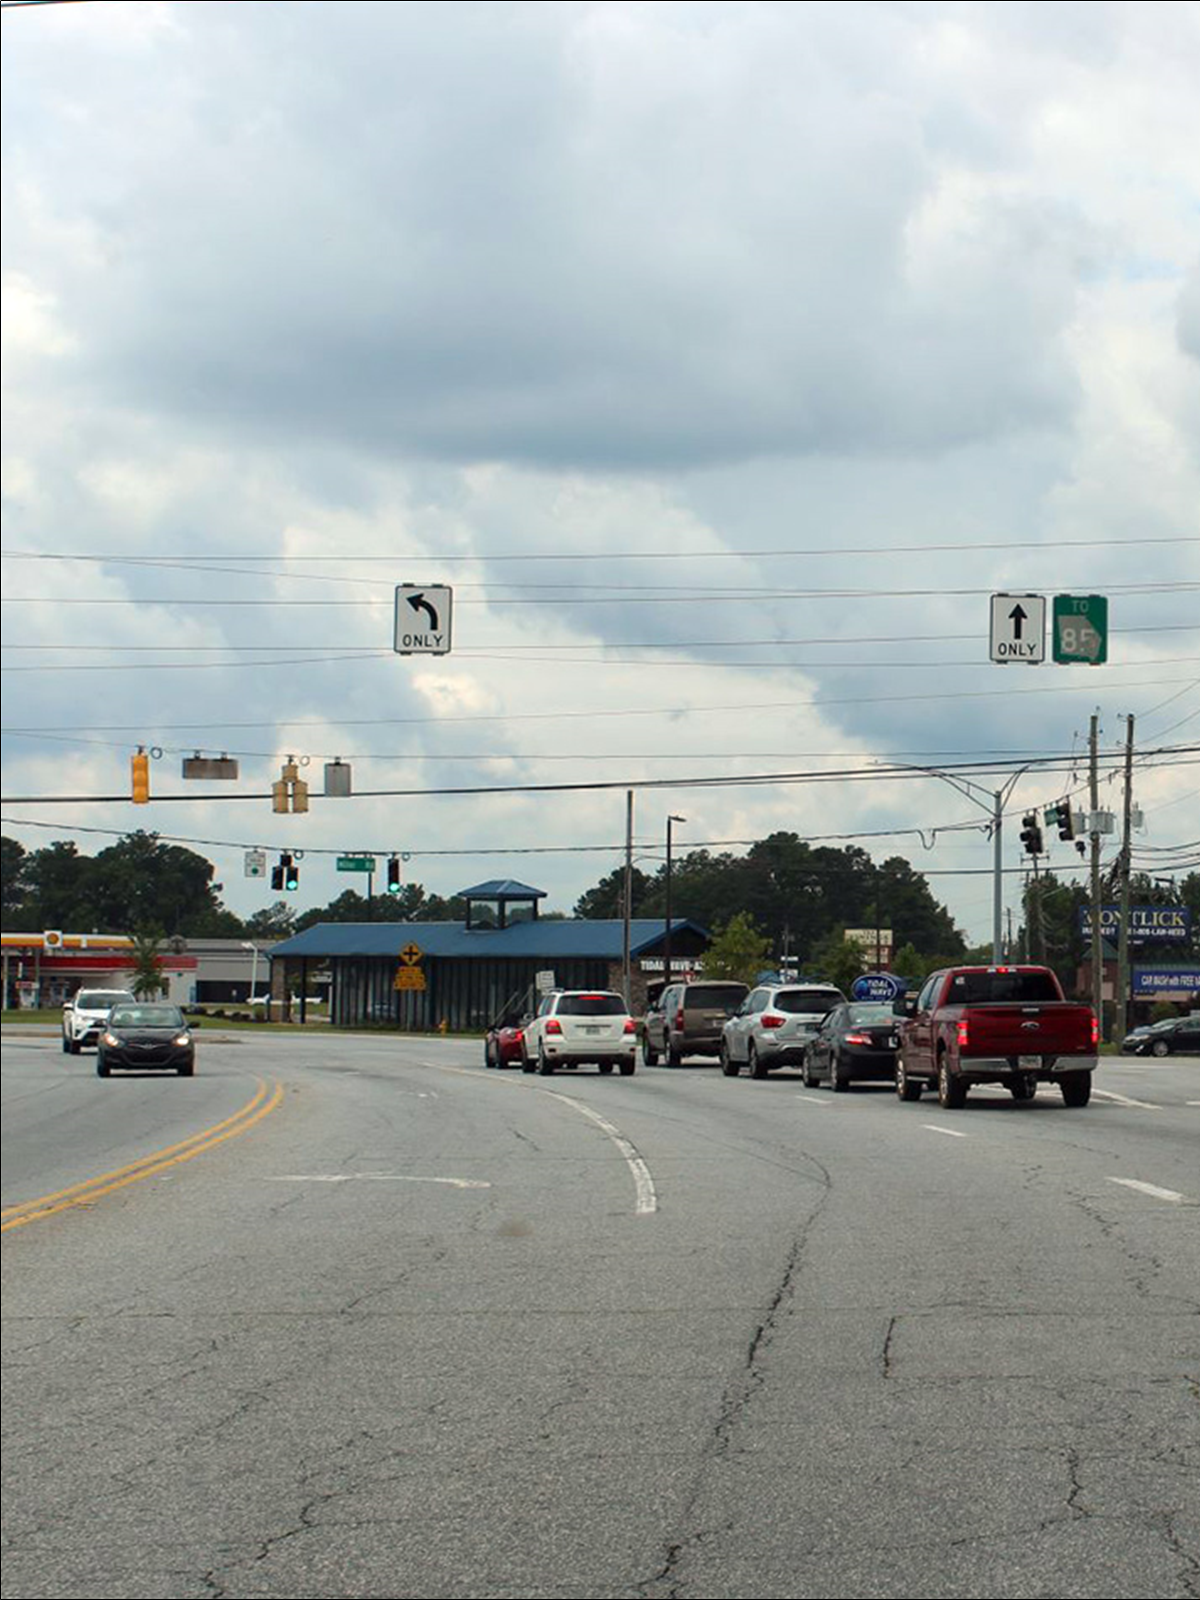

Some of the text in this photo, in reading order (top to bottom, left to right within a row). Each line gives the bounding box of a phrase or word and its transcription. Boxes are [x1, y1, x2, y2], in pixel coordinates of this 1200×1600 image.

[1070, 600, 1089, 613] TO
[402, 634, 443, 647] ONLY
[1062, 628, 1096, 653] 85
[998, 643, 1036, 656] ONLY
[641, 960, 665, 970] TIDAL
[867, 979, 889, 988] TIDAL
